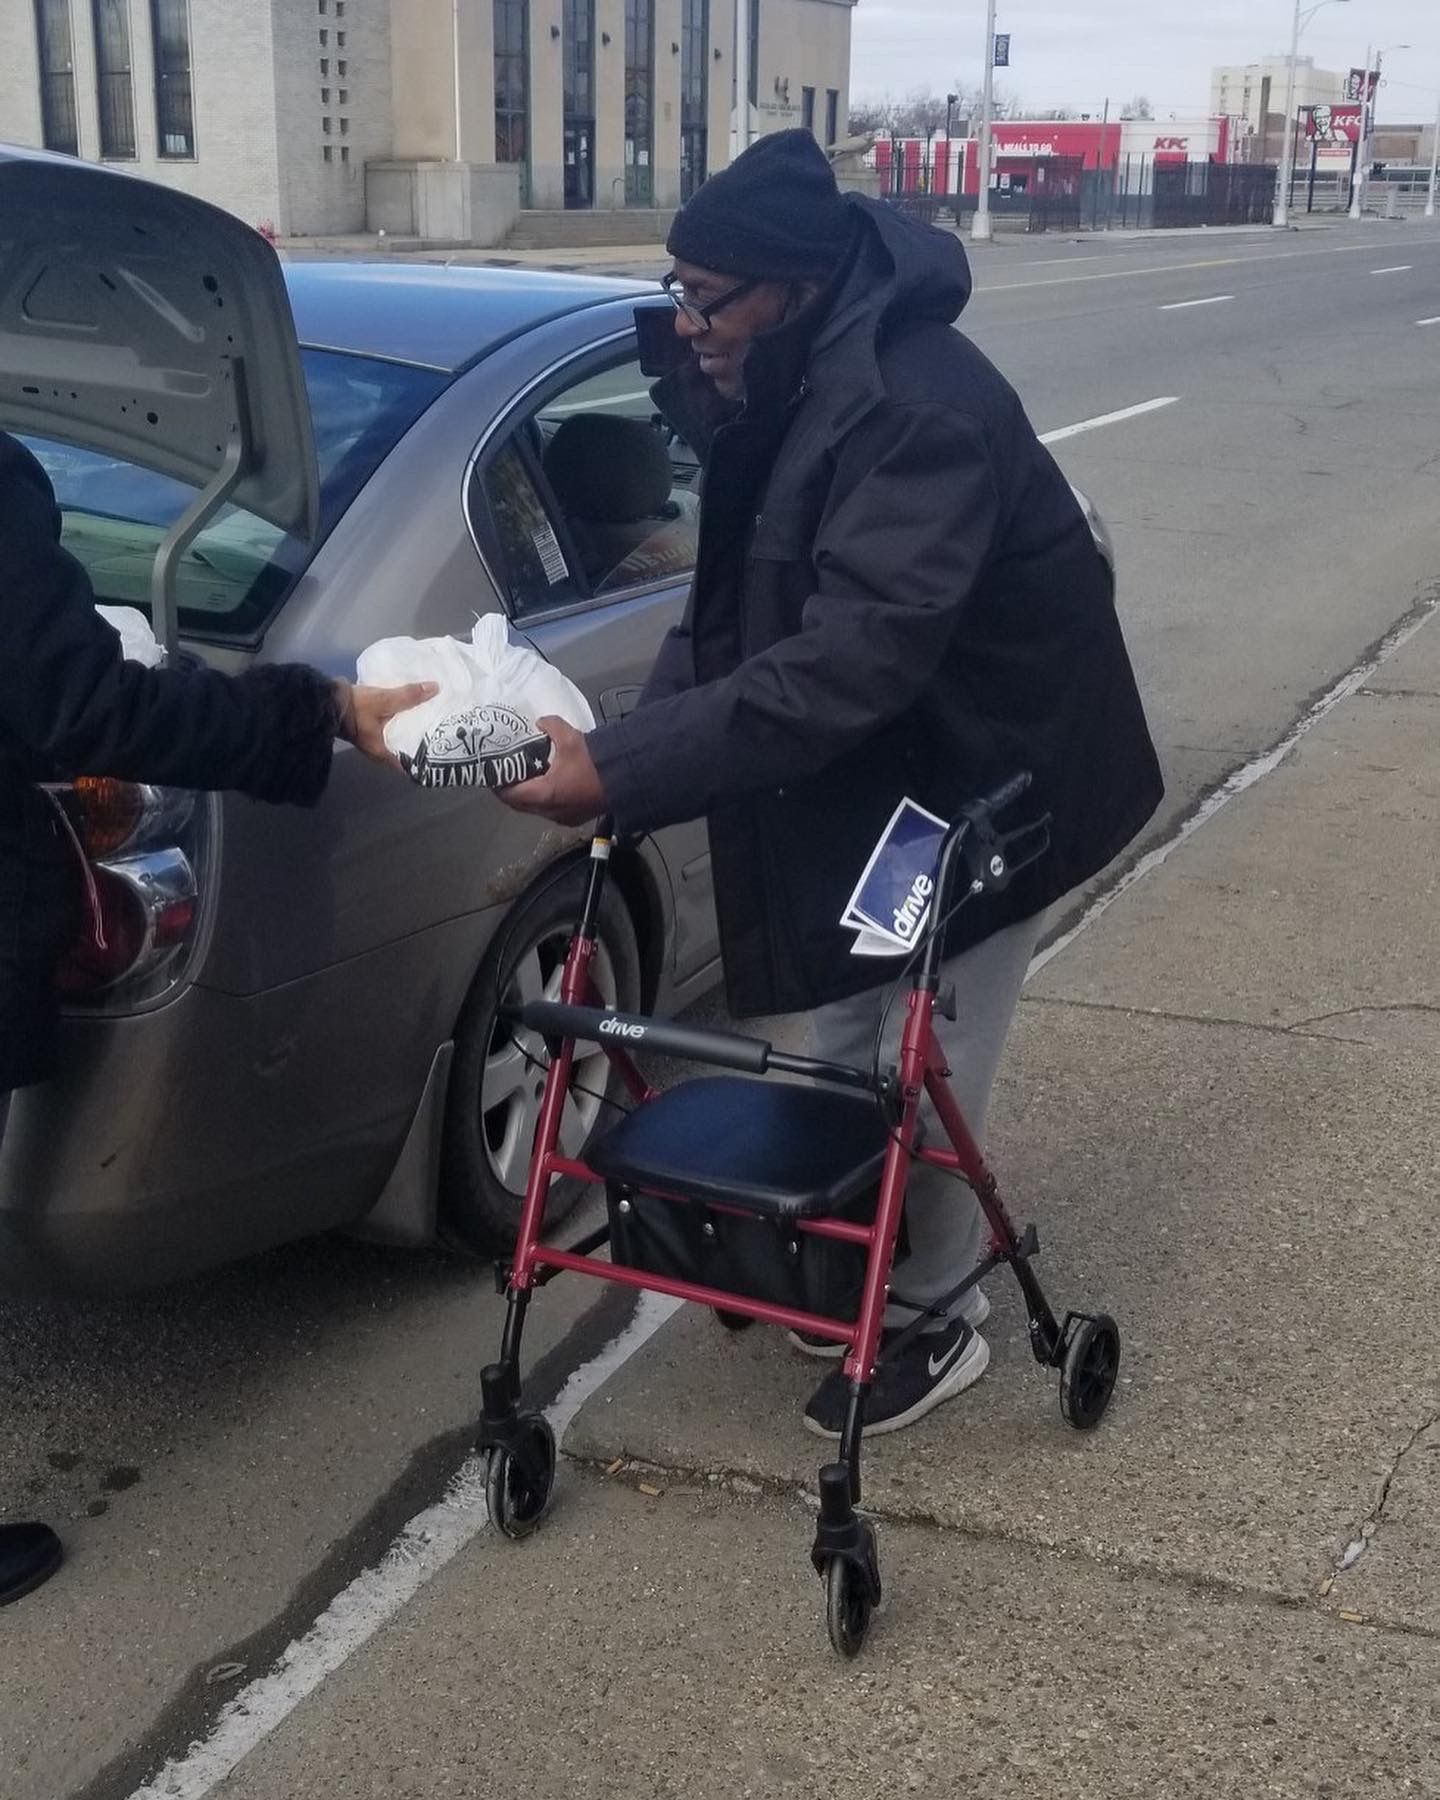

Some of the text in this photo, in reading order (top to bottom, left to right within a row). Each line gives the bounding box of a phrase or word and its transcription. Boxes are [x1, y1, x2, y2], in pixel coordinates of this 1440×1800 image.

[1152, 137, 1188, 150] KFC
[422, 751, 528, 787] THANK YOU
[894, 873, 933, 937] drive
[599, 1016, 645, 1038] drive
